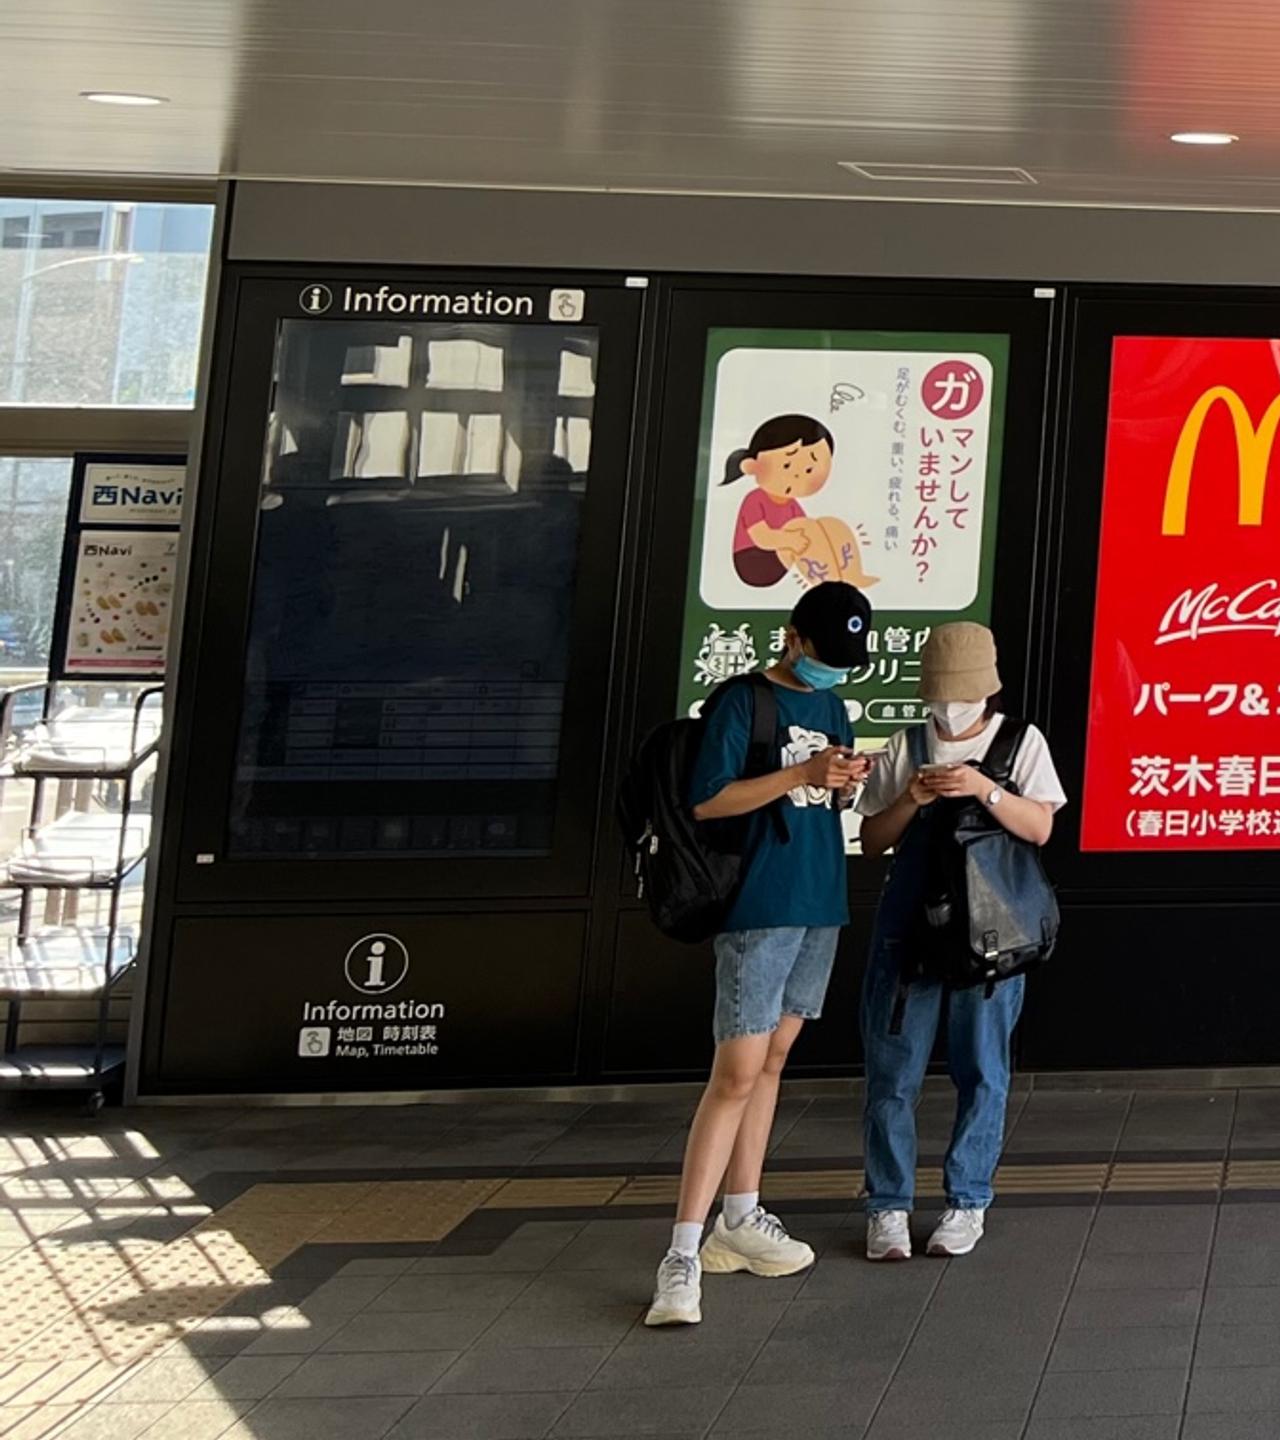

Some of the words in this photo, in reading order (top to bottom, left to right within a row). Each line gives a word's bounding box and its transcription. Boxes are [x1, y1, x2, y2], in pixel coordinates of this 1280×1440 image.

[343, 286, 534, 316] Information
[931, 370, 977, 412] ガ
[945, 427, 974, 530] マンして
[911, 426, 944, 583] いませんか?
[303, 999, 445, 1021] Information
[336, 1026, 374, 1042] 地図
[382, 1024, 437, 1042] 時刻表
[335, 1044, 370, 1058] Map,
[371, 1042, 439, 1056] Timetable
